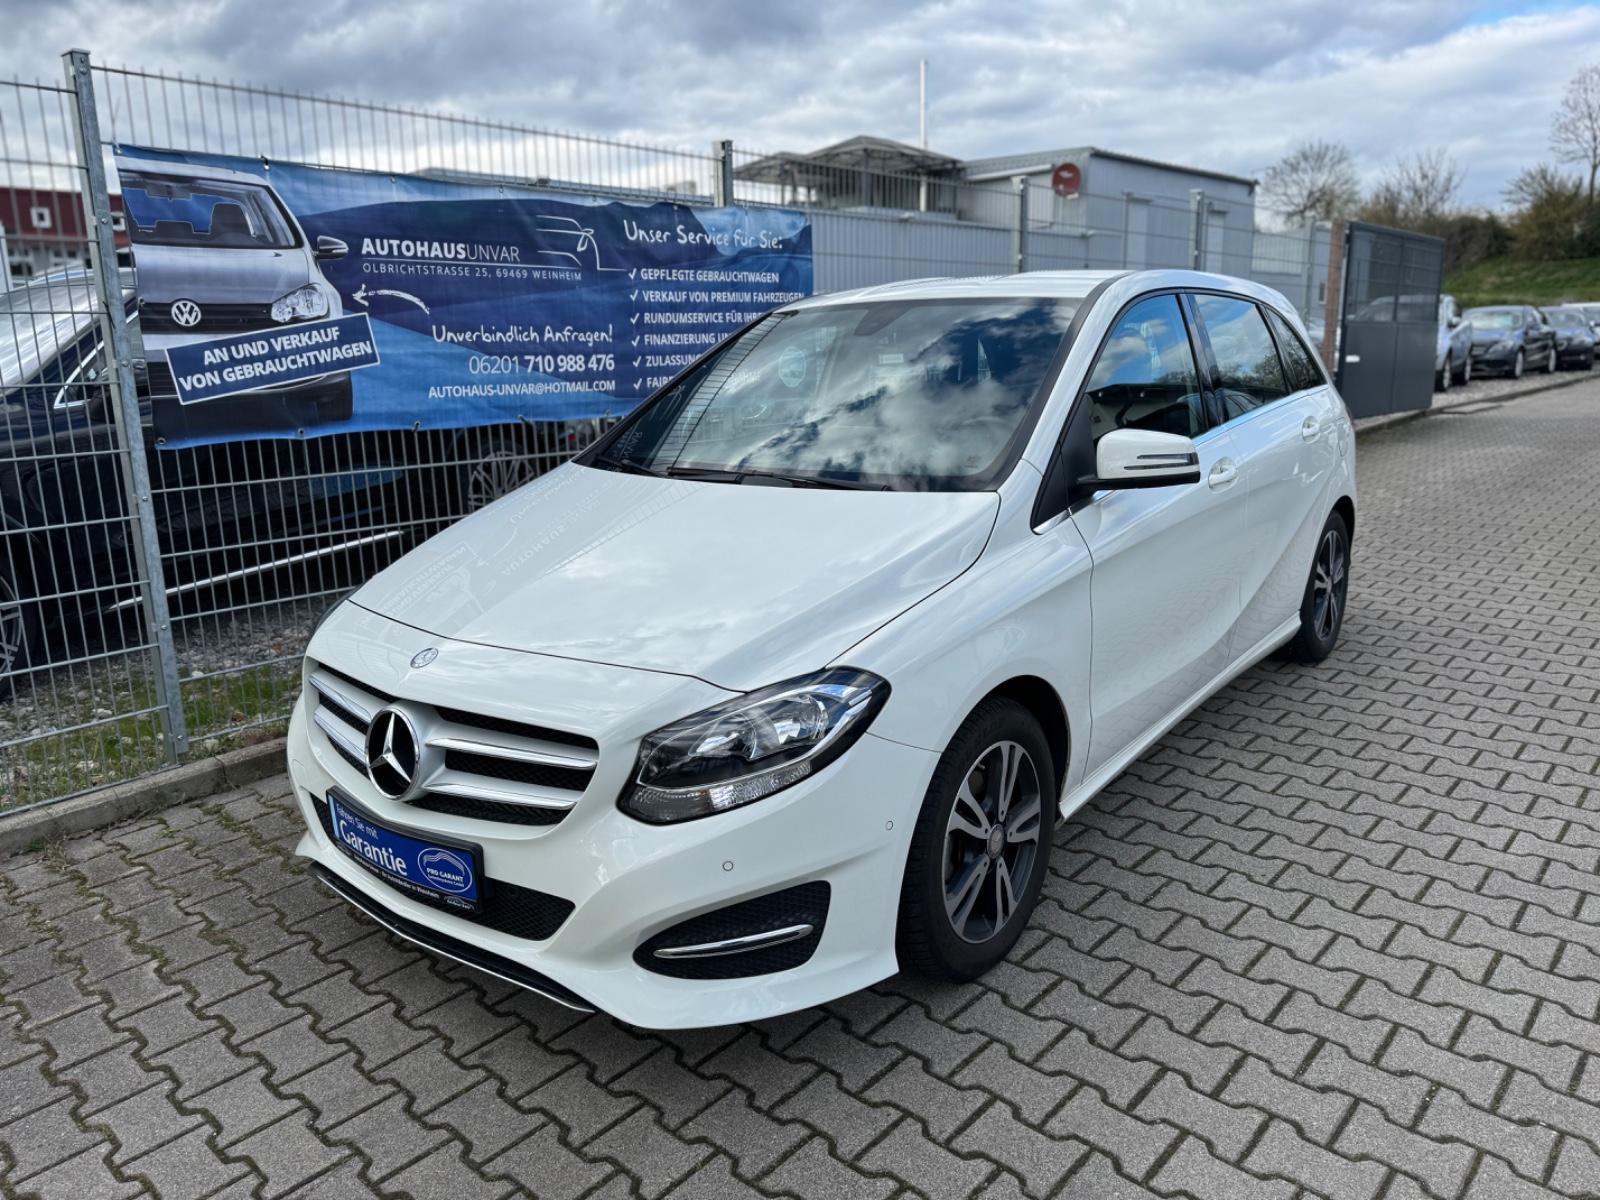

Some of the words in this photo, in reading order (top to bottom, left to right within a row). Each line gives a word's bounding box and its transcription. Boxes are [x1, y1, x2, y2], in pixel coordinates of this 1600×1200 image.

[623, 219, 671, 243] Unser
[677, 225, 729, 246] Service
[733, 230, 755, 246] für
[759, 230, 783, 249] Sie:
[362, 263, 470, 277] OLBRICHTSTRASSE
[475, 268, 492, 279] 25,
[496, 269, 528, 279] 69469
[532, 270, 582, 281] WEINHEIM
[640, 268, 695, 281] GEPFLEGTE
[696, 270, 780, 284] GEBRAUCHTWAGEN
[642, 290, 688, 302] VERKAUF
[689, 291, 709, 302] VON
[711, 291, 751, 303] PREMIUM
[644, 312, 725, 324] RUNDUMSERVICE
[726, 310, 743, 323] FÜR
[432, 324, 540, 343] Unverbindlich
[543, 324, 614, 347] Anfragen!
[644, 333, 716, 346] FINANZIERUNG
[204, 348, 229, 366] AN
[231, 340, 269, 360] UND
[272, 327, 340, 352] VERKAUF
[179, 371, 220, 393] VON
[222, 341, 372, 382] GEBRAUCHTWAGEN
[469, 355, 520, 374] 06201
[524, 355, 555, 373] 710
[558, 354, 586, 373] 988
[588, 354, 615, 371] 476
[428, 380, 615, 399] AUTOHAUS-UNVAR@HOTMAIL.COM
[339, 820, 408, 877] Garantie
